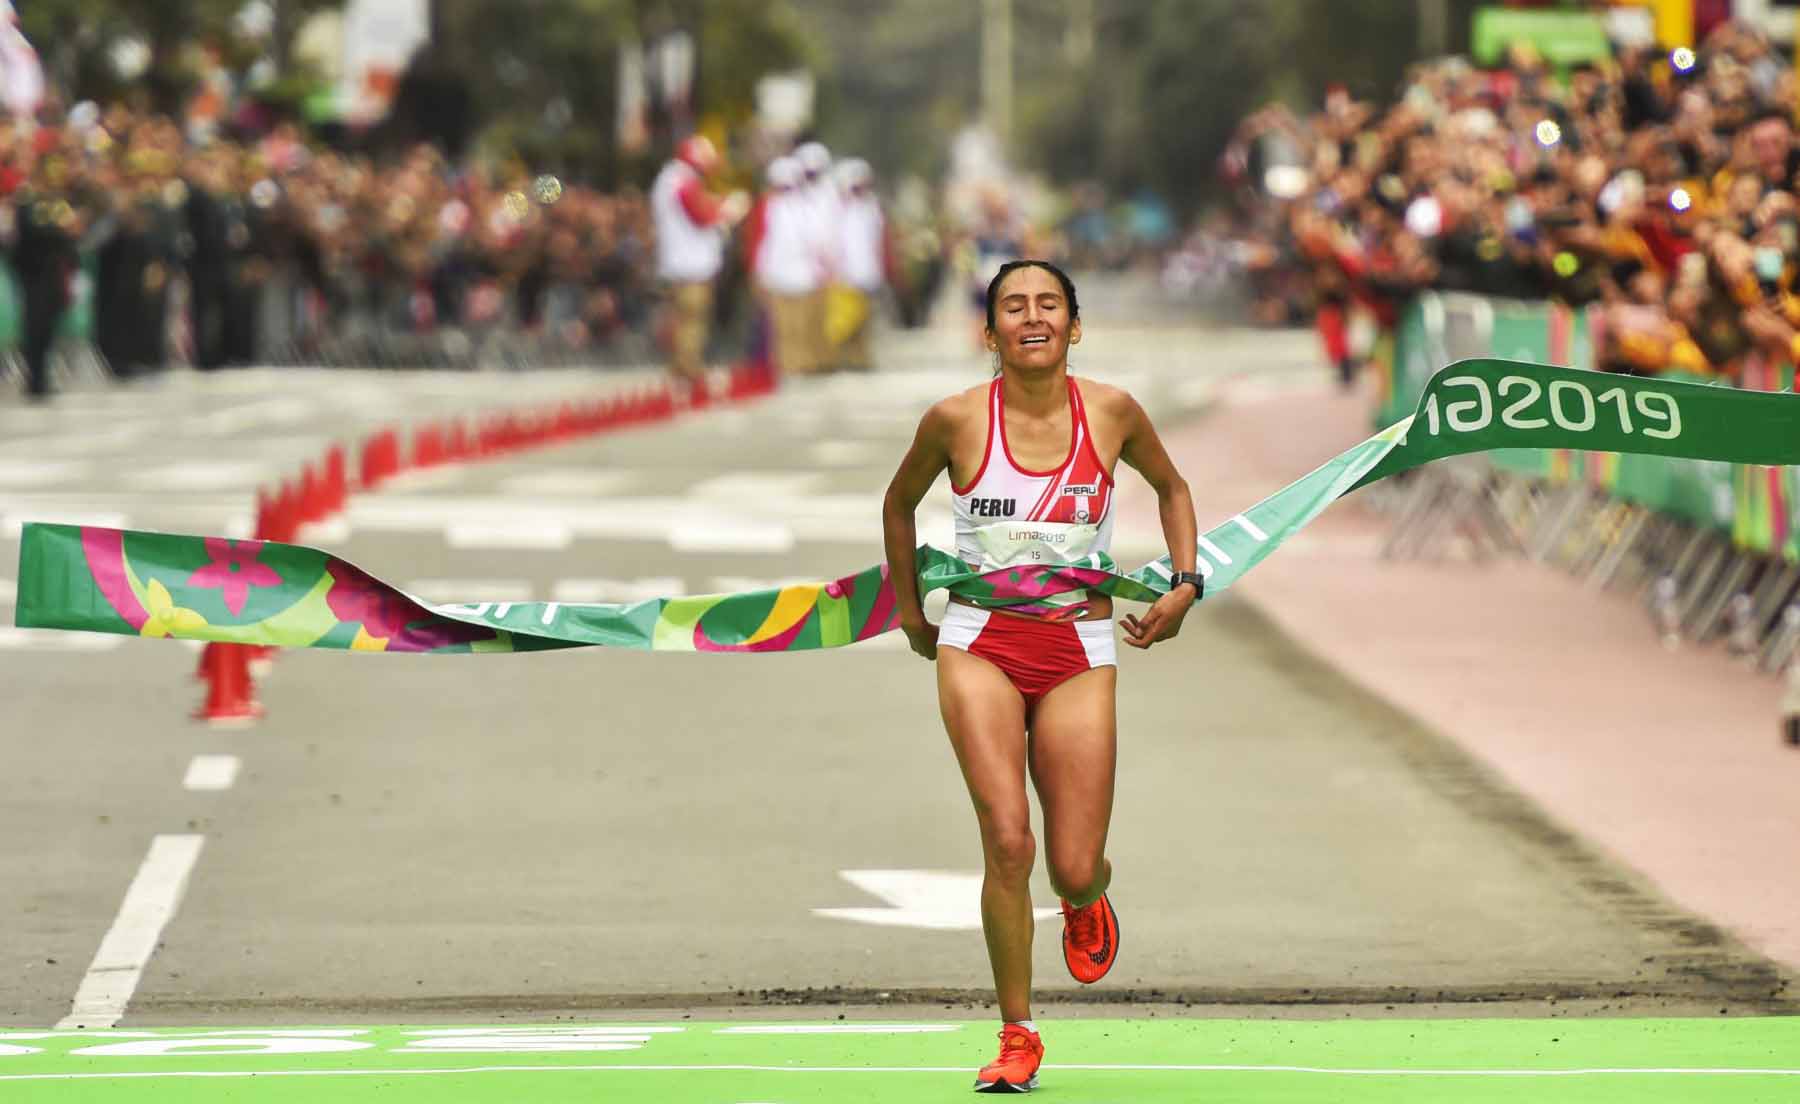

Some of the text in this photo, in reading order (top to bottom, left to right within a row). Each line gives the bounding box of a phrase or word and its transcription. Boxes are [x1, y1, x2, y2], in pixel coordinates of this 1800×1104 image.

[1064, 486, 1097, 495] PERU
[970, 497, 1016, 518] PERU
[1008, 530, 1066, 544] Lima2019
[1031, 551, 1041, 560] 15
